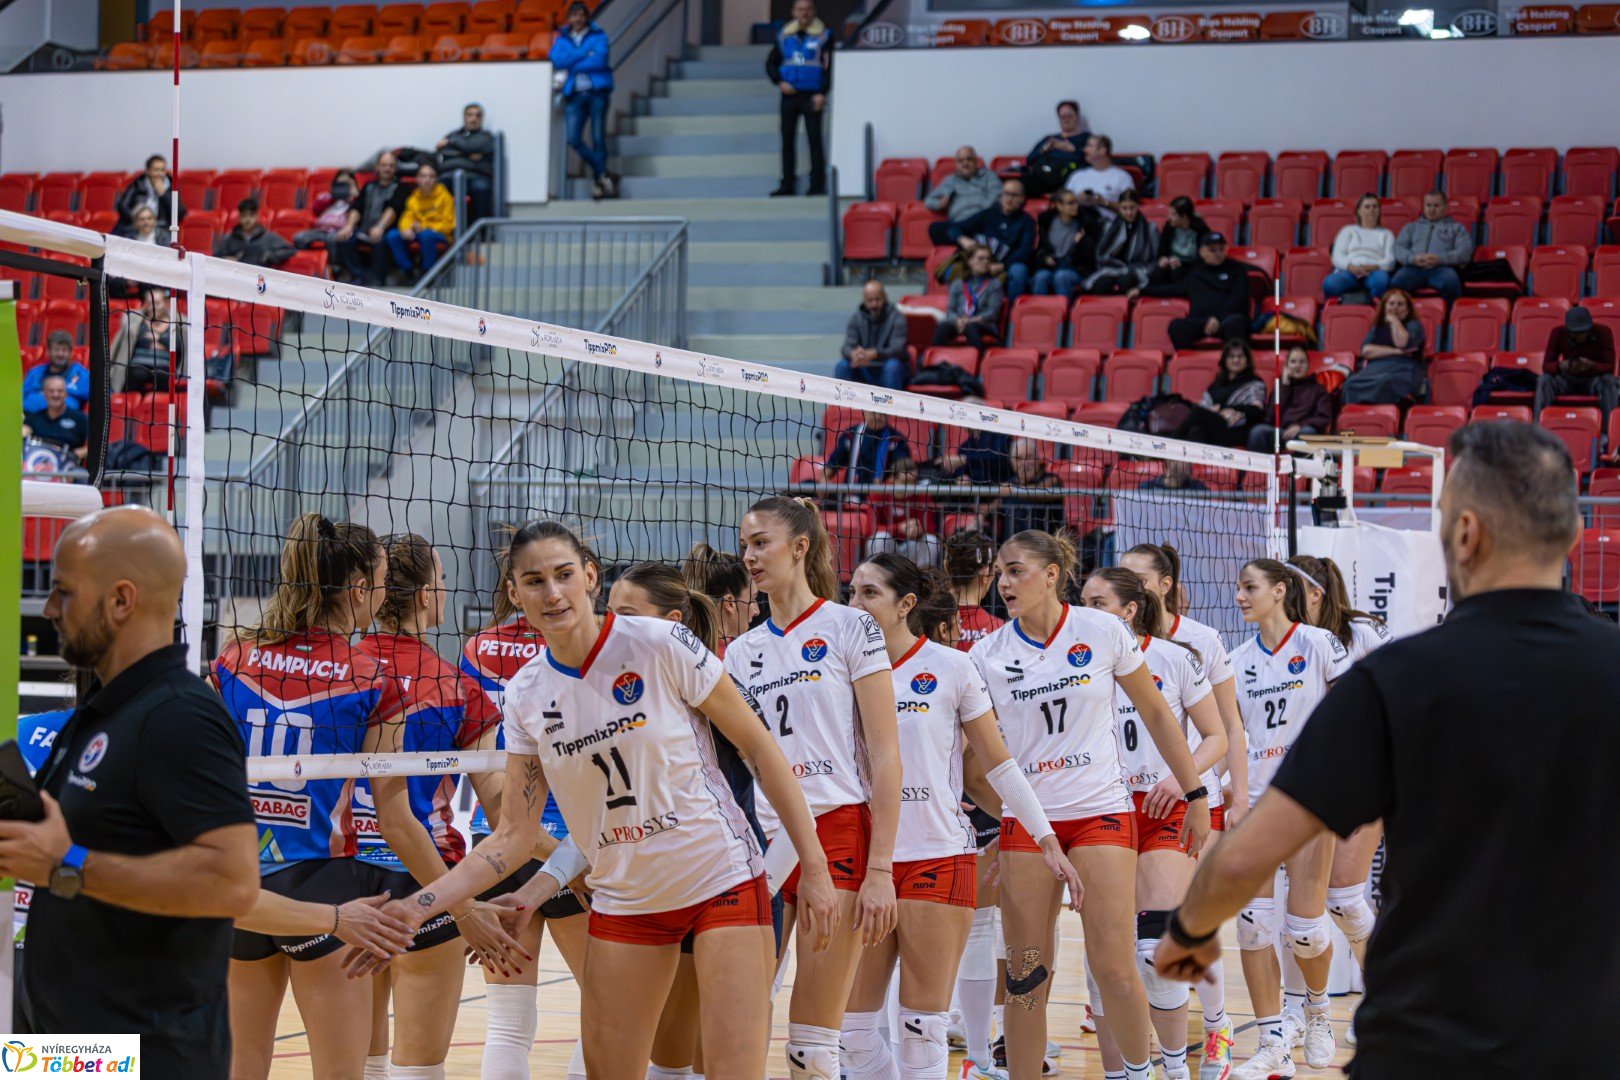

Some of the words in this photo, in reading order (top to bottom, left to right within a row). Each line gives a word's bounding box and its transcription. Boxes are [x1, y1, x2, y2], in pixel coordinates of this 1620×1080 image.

[1222, 16, 1260, 27] Holding
[1462, 14, 1490, 31] BH
[1530, 9, 1570, 20] Holding
[1075, 19, 1111, 31] Holding
[1157, 21, 1186, 38] BH
[1308, 16, 1337, 34] BH
[389, 301, 431, 321] TippmixPRO
[584, 338, 617, 356] TippmixPRO
[247, 647, 349, 681] PAMPUCH
[748, 670, 822, 698] TippmixPRO
[1007, 674, 1025, 685] nine
[1011, 673, 1091, 701] TippmixPRO
[1247, 679, 1304, 700] TippmixPRO
[776, 694, 793, 737] 2
[897, 701, 930, 713] PRO
[1039, 697, 1069, 735] 17
[1265, 698, 1287, 730] 22
[545, 720, 565, 735] nine
[552, 712, 648, 757] TippmixPRO
[246, 709, 314, 792] 10
[426, 757, 459, 772] TippmixPRO
[592, 746, 634, 797] 11
[792, 759, 834, 777] OSYS
[901, 787, 930, 800] SYS
[1005, 820, 1015, 836] 17
[912, 881, 936, 890] nine
[712, 898, 739, 908] nine
